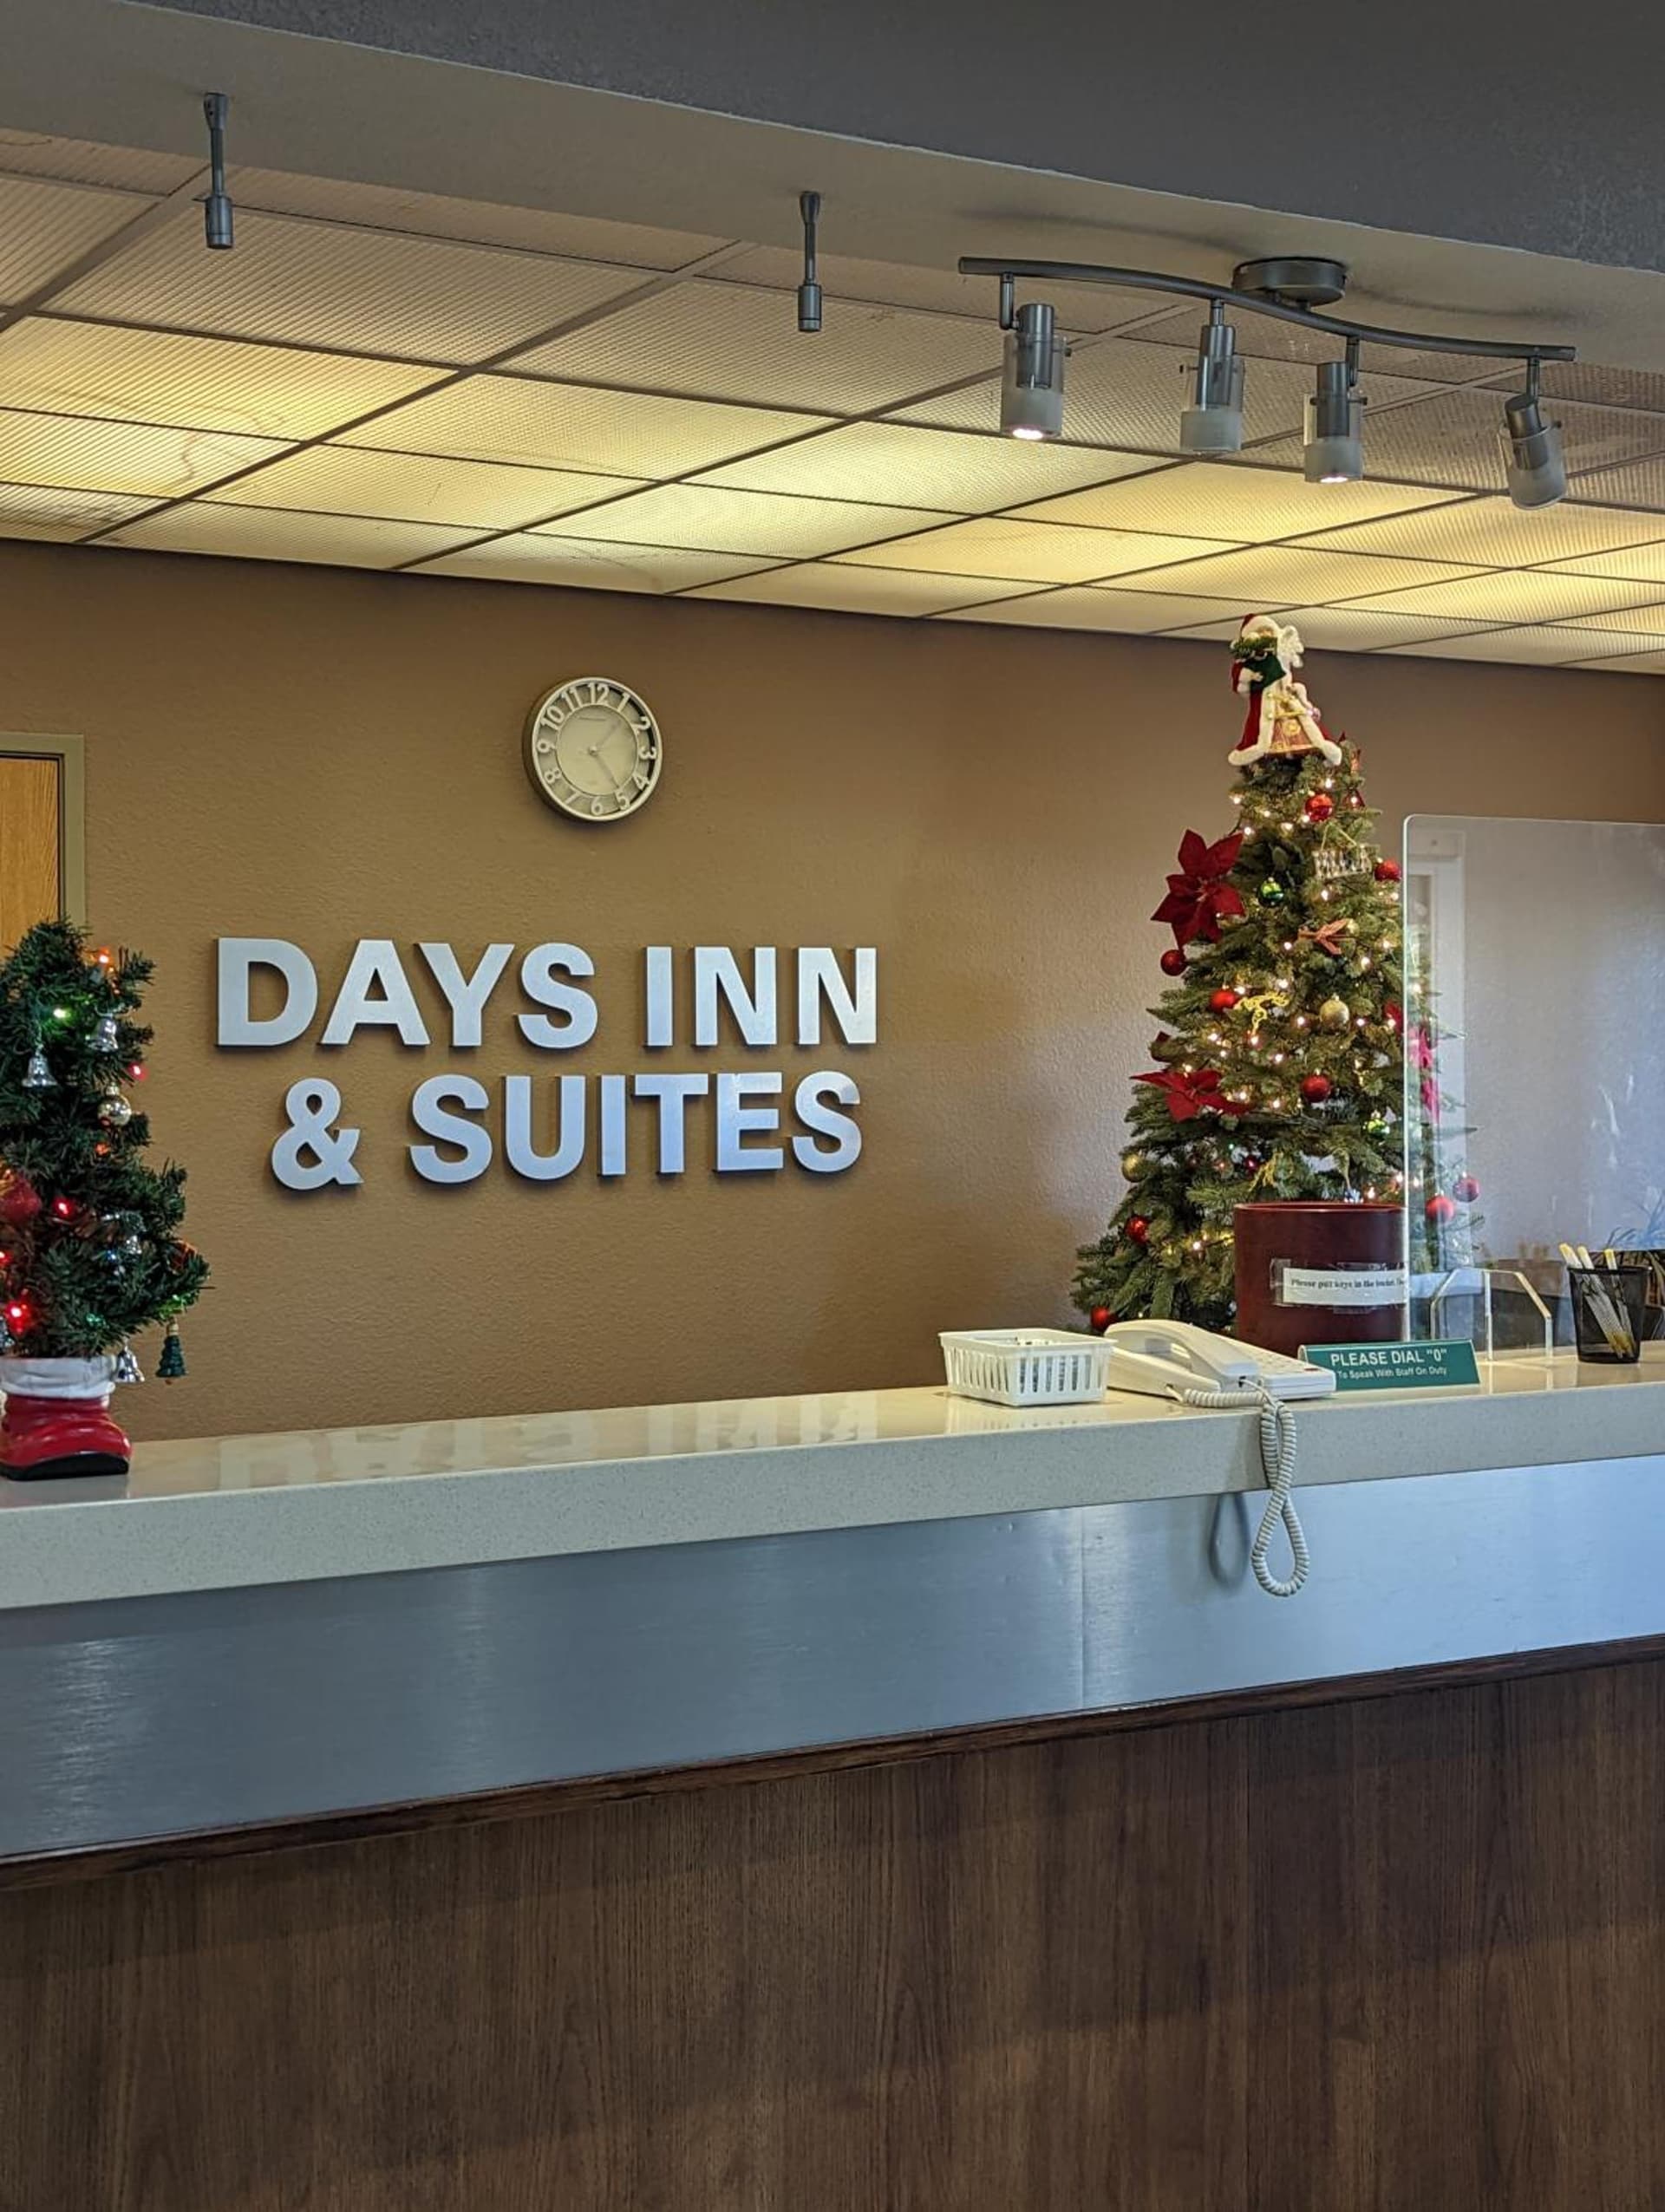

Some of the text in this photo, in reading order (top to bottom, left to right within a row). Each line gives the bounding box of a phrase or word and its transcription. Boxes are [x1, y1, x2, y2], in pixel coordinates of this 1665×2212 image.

[561, 686, 583, 711] 11
[588, 682, 610, 705] 12
[617, 693, 631, 713] 1
[540, 706, 565, 730] 10
[630, 716, 650, 732] 2
[537, 740, 556, 753] 9
[638, 747, 656, 760] 3
[545, 768, 561, 784] 8
[632, 773, 650, 789] 4
[565, 790, 582, 805] 7
[591, 796, 603, 816] 6
[615, 789, 630, 810] 5
[216, 937, 877, 1049] DAYS INN
[271, 1070, 862, 1191] & SUITES
[1290, 1278, 1316, 1288] Please
[1363, 1279, 1374, 1288] the
[1330, 1348, 1447, 1367] PLEASE DIAL "0"
[1337, 1366, 1447, 1380] To Speak With Staff On Duty
